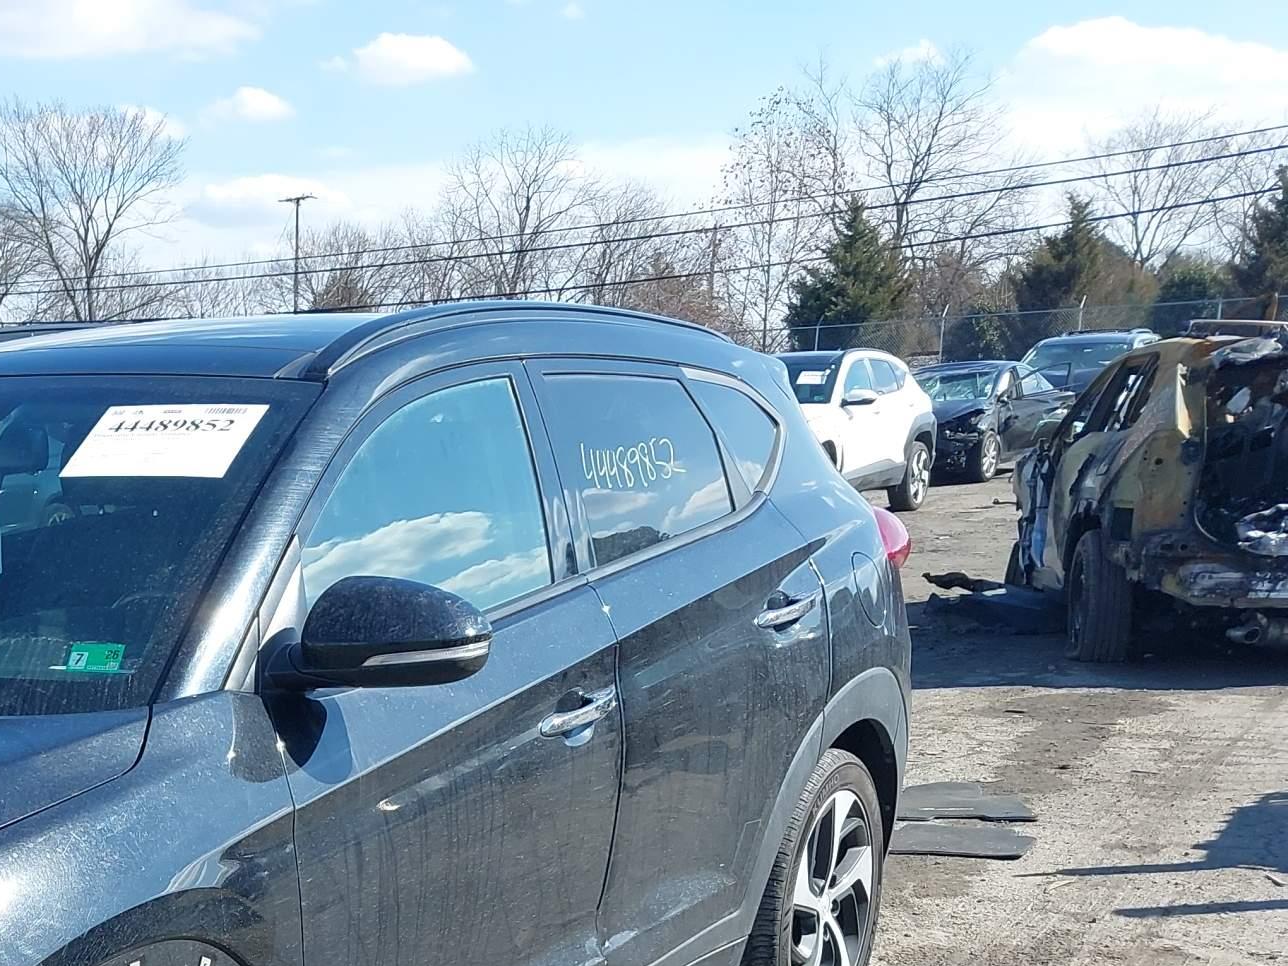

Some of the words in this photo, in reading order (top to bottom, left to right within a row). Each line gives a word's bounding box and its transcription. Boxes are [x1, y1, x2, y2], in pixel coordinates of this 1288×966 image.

[108, 418, 235, 433] 44489852
[579, 437, 688, 489] 44489852
[74, 653, 85, 665] 7
[812, 774, 840, 817] KUMHO
